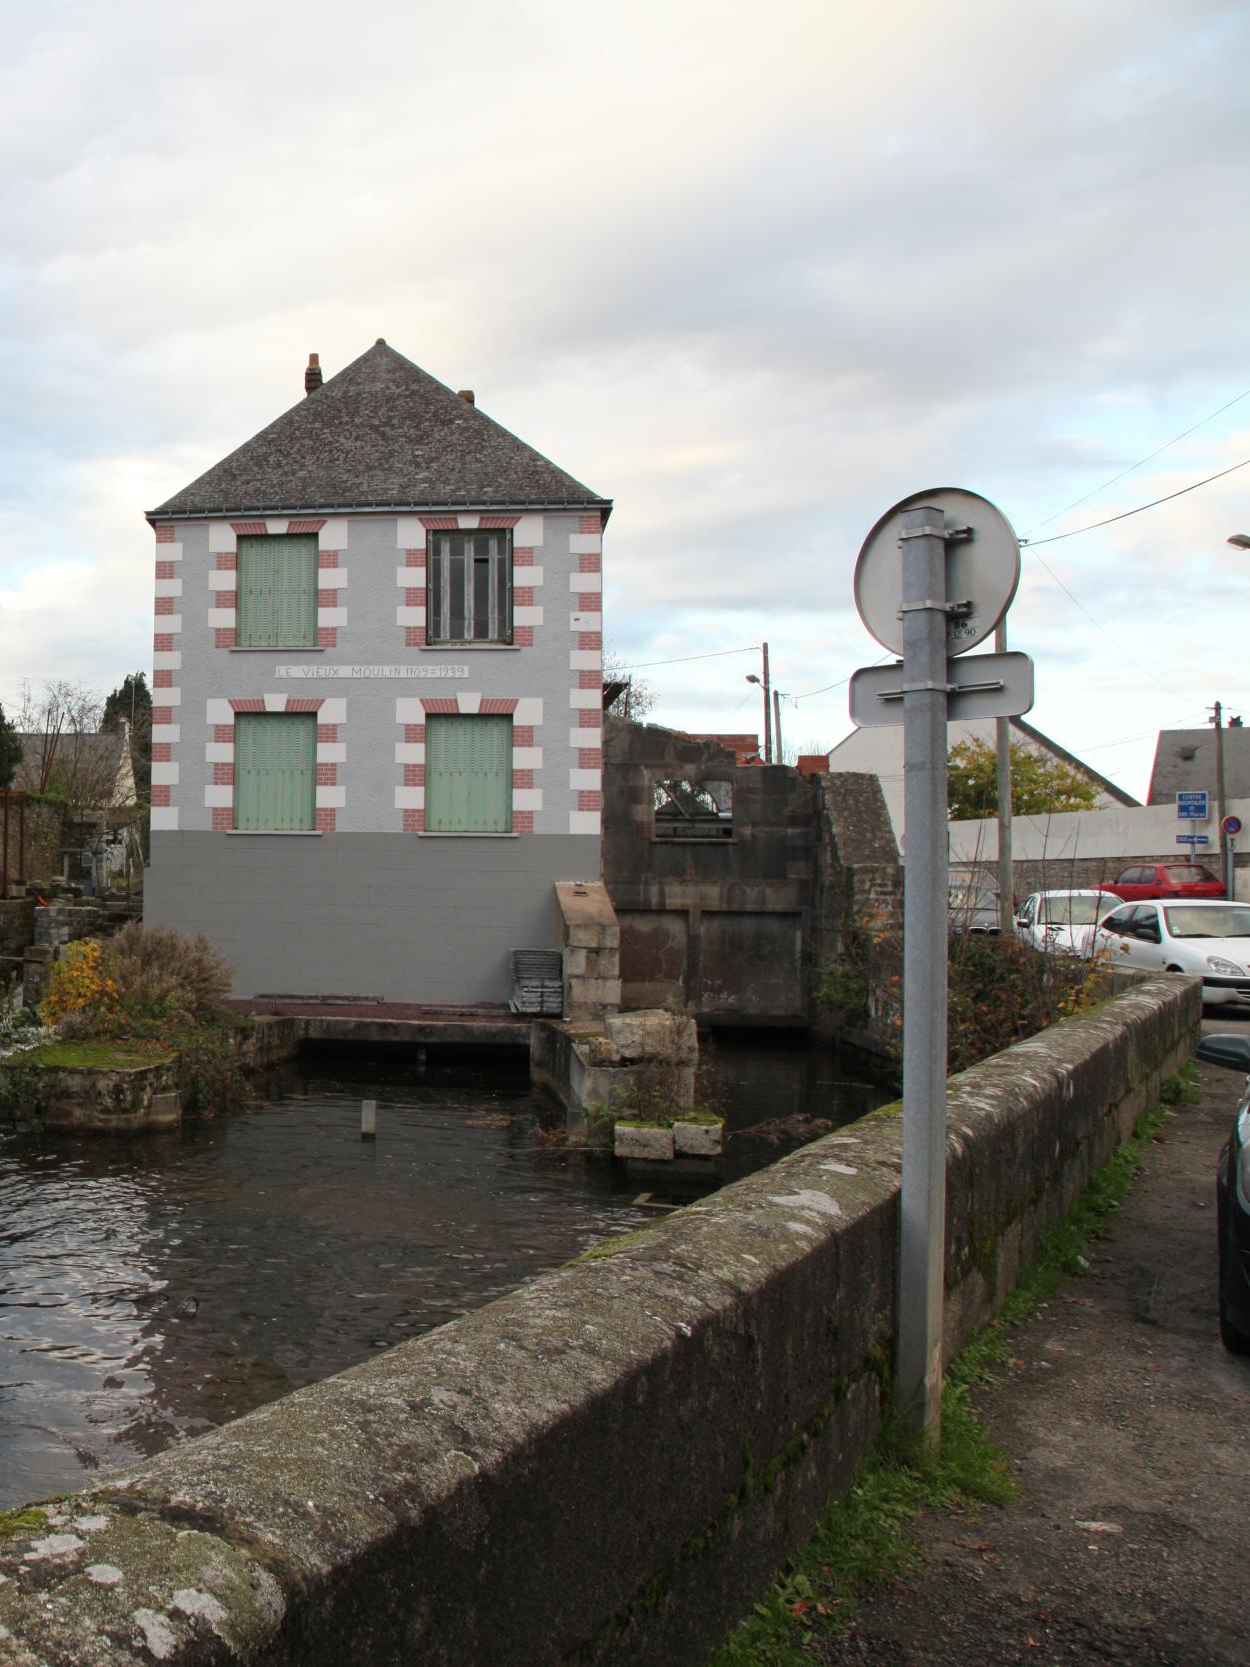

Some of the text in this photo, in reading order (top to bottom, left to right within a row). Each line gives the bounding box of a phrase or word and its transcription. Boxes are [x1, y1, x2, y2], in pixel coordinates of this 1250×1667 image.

[277, 667, 292, 677] LE
[302, 667, 340, 677] VIEUX
[351, 667, 405, 678] MOULIN
